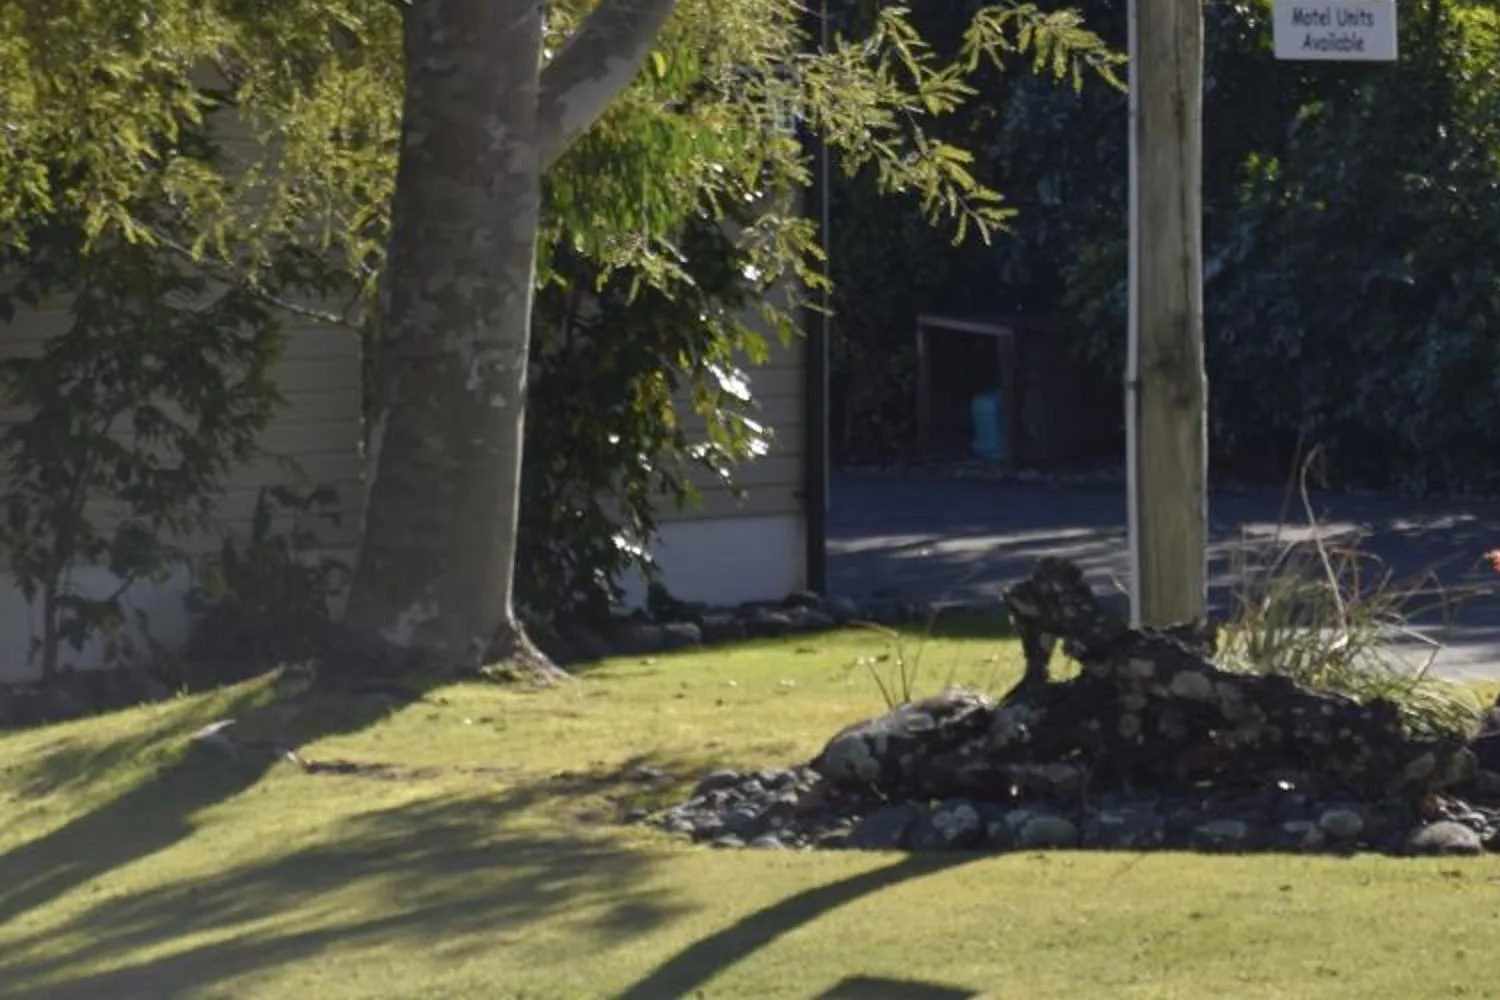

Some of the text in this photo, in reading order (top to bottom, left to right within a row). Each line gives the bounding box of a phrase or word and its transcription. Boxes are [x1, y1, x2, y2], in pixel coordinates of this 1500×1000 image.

[1291, 6, 1376, 28] Motel Units
[1301, 31, 1366, 52] Available
